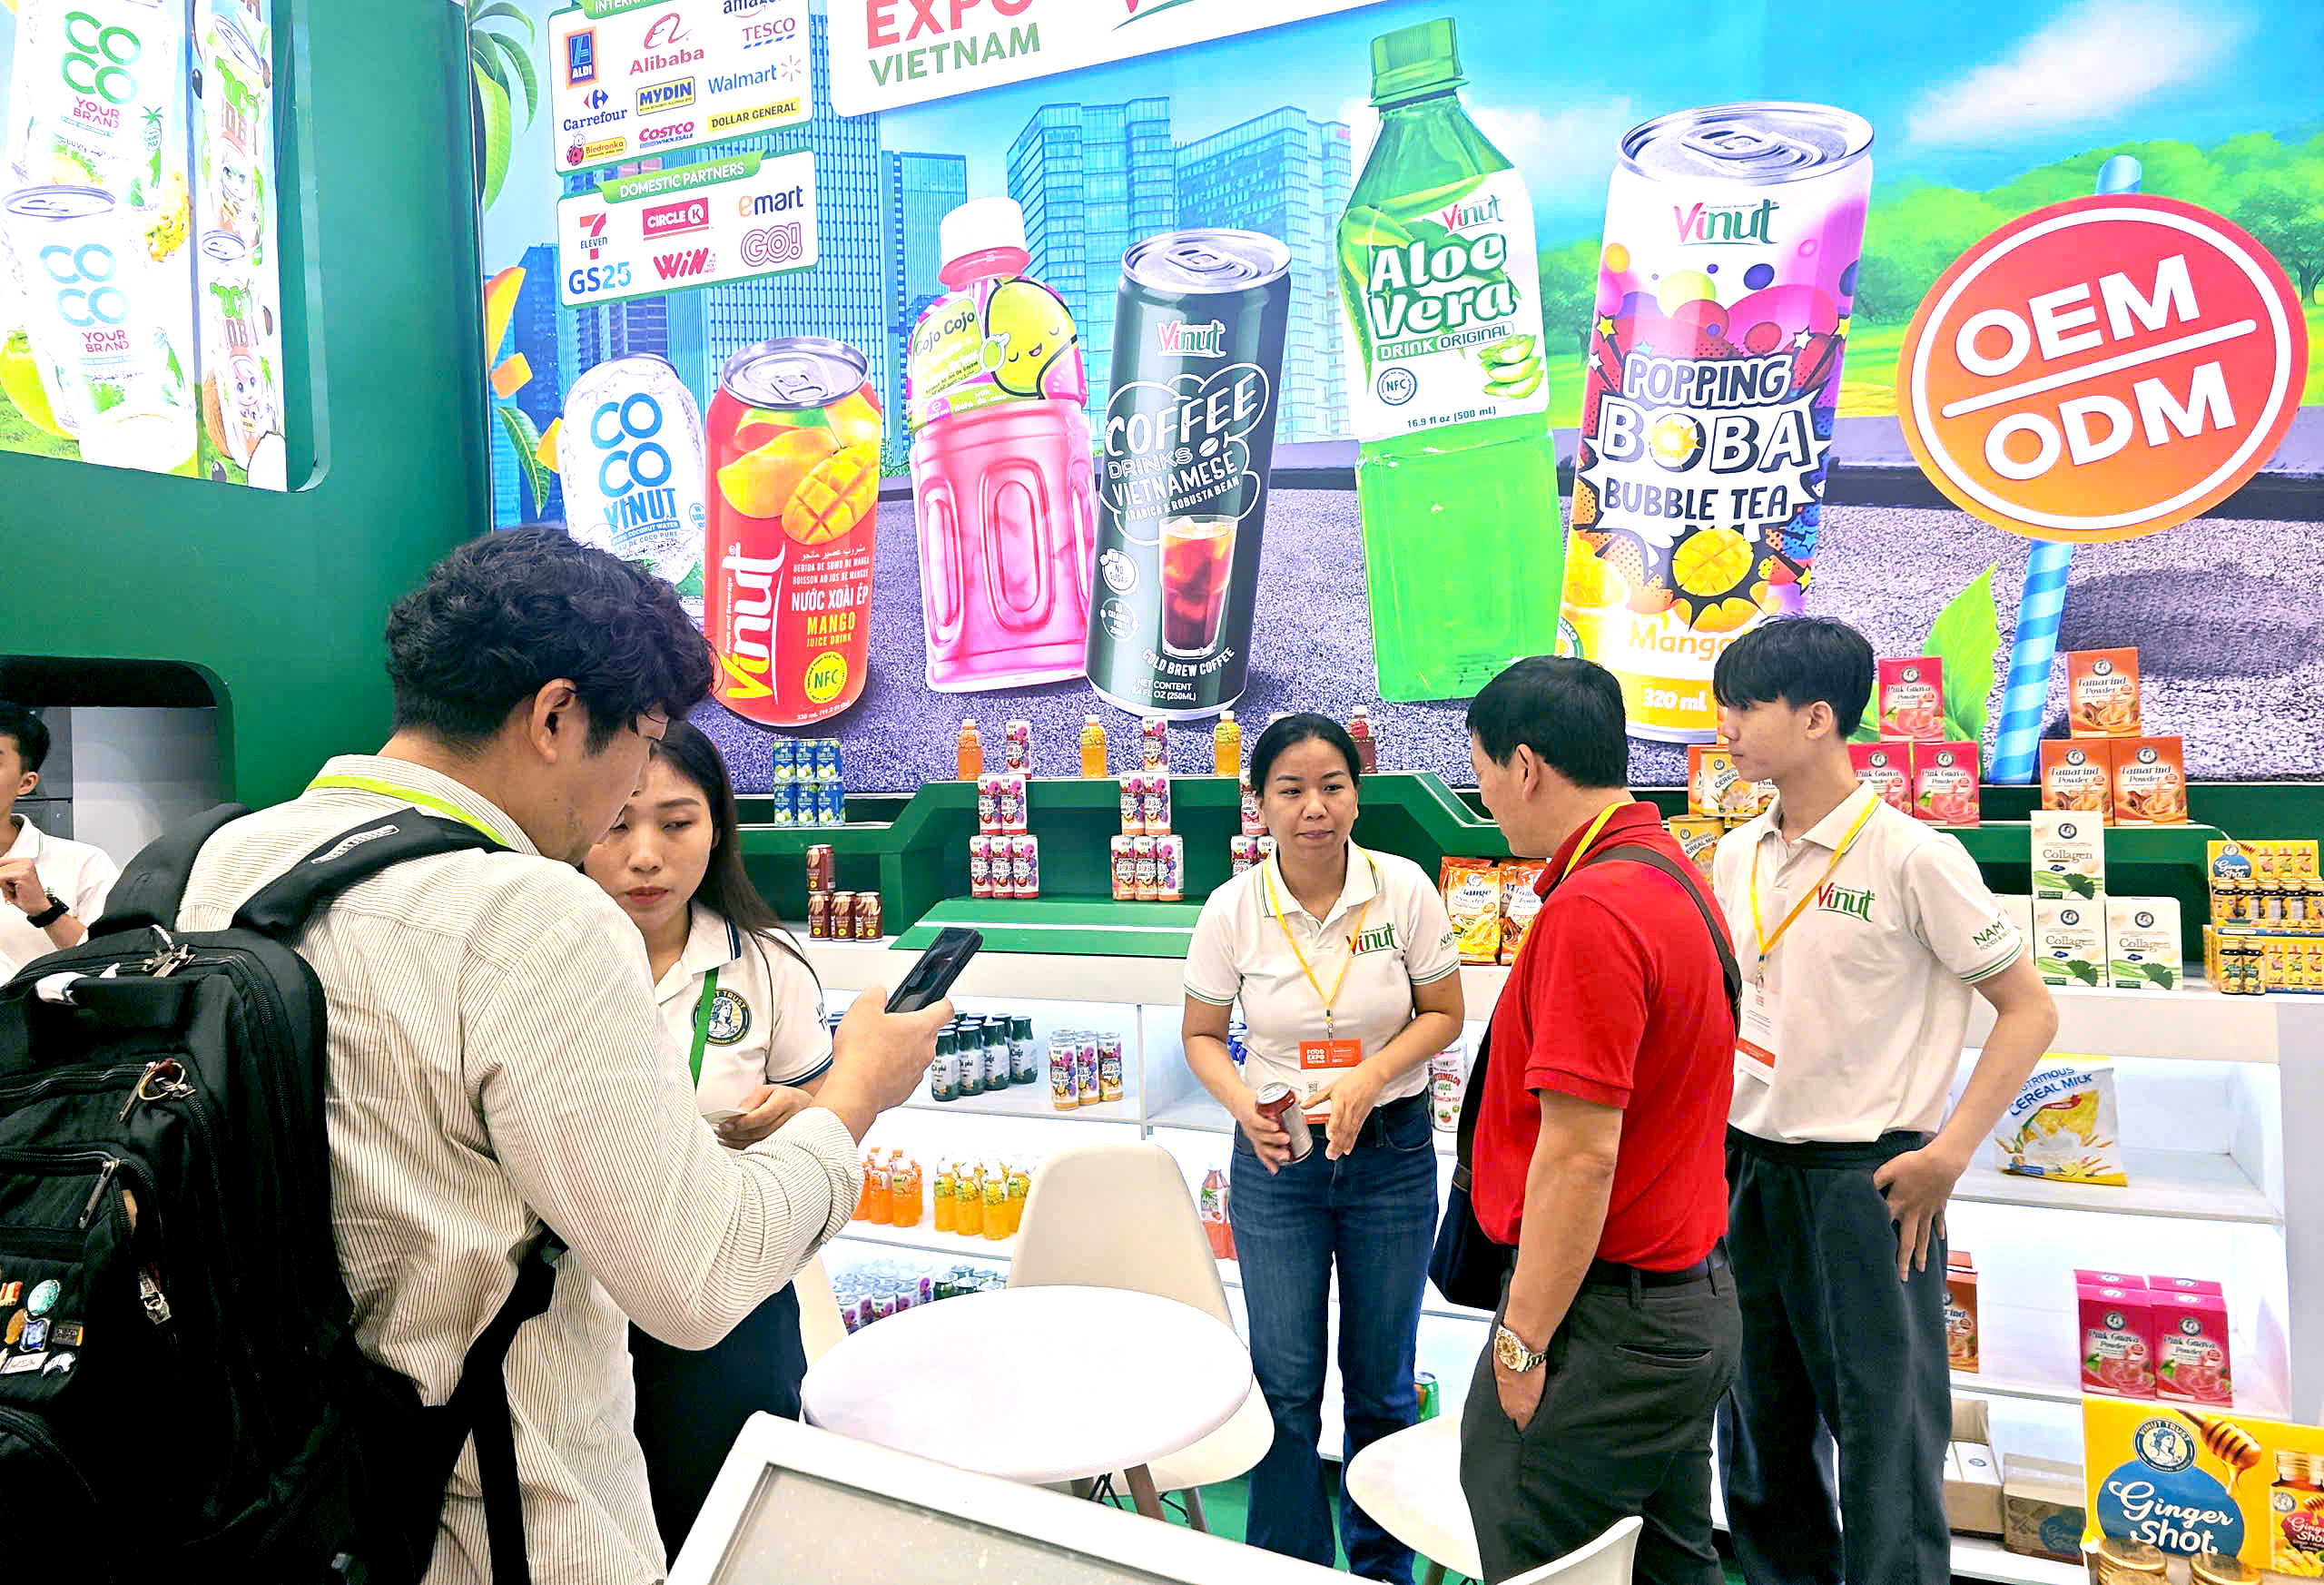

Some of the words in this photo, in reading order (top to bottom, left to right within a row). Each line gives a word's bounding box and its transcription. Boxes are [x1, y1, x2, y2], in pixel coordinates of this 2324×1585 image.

[743, 17, 795, 43] TESCO
[630, 48, 704, 75] Alibaba
[868, 23, 1040, 86] VIETNAM
[572, 65, 593, 80] ALDI
[708, 64, 777, 94] Walmart
[75, 96, 120, 120] YOUR
[639, 82, 693, 106] MYDIN
[73, 107, 120, 128] BRAND
[563, 108, 627, 132] Carrefour
[712, 113, 750, 128] DOLLAR
[752, 102, 796, 119] GENERAL
[639, 122, 694, 142] COSTCO
[619, 173, 681, 198] DOMESTIC
[683, 162, 744, 186] PARTNERS
[739, 185, 803, 218] emart
[1442, 194, 1503, 232] Vinut
[646, 209, 686, 228] CIRCLE
[1674, 199, 1780, 244] Vinut
[580, 236, 607, 249] ELEVEN
[740, 222, 803, 267] GO!
[569, 261, 631, 295] GS25
[1368, 233, 1507, 294] Aloe
[1369, 281, 1517, 340] Vera
[1955, 253, 2201, 377] OEM
[82, 330, 126, 343] YOUR
[85, 340, 129, 353] BRAND
[914, 330, 940, 356] Cojo
[943, 311, 975, 335] Cojo
[1157, 320, 1226, 357] Vinut
[1379, 338, 1435, 359] DRINK
[1440, 323, 1511, 349] ORIGINAL
[1386, 380, 1406, 392] NFC
[1628, 359, 1787, 405] POPPING
[590, 392, 663, 450] CO
[1105, 371, 1258, 457] COFFEE
[1408, 417, 1426, 428] 16.9
[1429, 416, 1437, 425] fl
[1440, 415, 1450, 423] oz
[1453, 409, 1475, 422] (500
[1984, 360, 2237, 481] ODM
[1601, 404, 1812, 475] BOBA
[598, 442, 672, 498] CO
[1108, 447, 1193, 478] DRINKS
[1111, 450, 1238, 507] VIETNAMESE
[603, 487, 677, 536] VINUT
[1125, 504, 1163, 523] ARABICA
[1172, 487, 1214, 511] ROBUSTA
[1215, 476, 1240, 494] BEAN
[1604, 477, 1718, 520] BUBBLE
[1730, 486, 1787, 519] TEA
[792, 588, 825, 612] NƯỚC
[827, 584, 854, 609] XOÀI
[856, 582, 869, 605] ÉP
[806, 611, 856, 635] MANGO
[806, 635, 827, 647] JUICE
[830, 632, 852, 645] DRINK
[1141, 648, 1167, 672] COLD
[1167, 663, 1197, 677] BREW
[1199, 646, 1236, 674] COFFEE
[814, 669, 839, 689] NFC
[1153, 680, 1192, 691] CONTENT
[1153, 690, 1167, 699] OZ
[1167, 691, 1196, 702] (250ML)
[1642, 688, 1677, 709] 320
[2043, 850, 2093, 863] Collagen
[1817, 881, 1876, 923] Vinut
[1345, 922, 1399, 958] Vinut
[1973, 920, 2005, 946] NAM
[2045, 935, 2095, 950] Collagen
[2119, 938, 2171, 952] Collagen
[722, 990, 747, 1009] TRUST
[2009, 1082, 2062, 1116] CEREAL
[2061, 1073, 2093, 1089] MILK
[2108, 1481, 2233, 1529] Ginger
[2130, 1521, 2218, 1554] Shot
